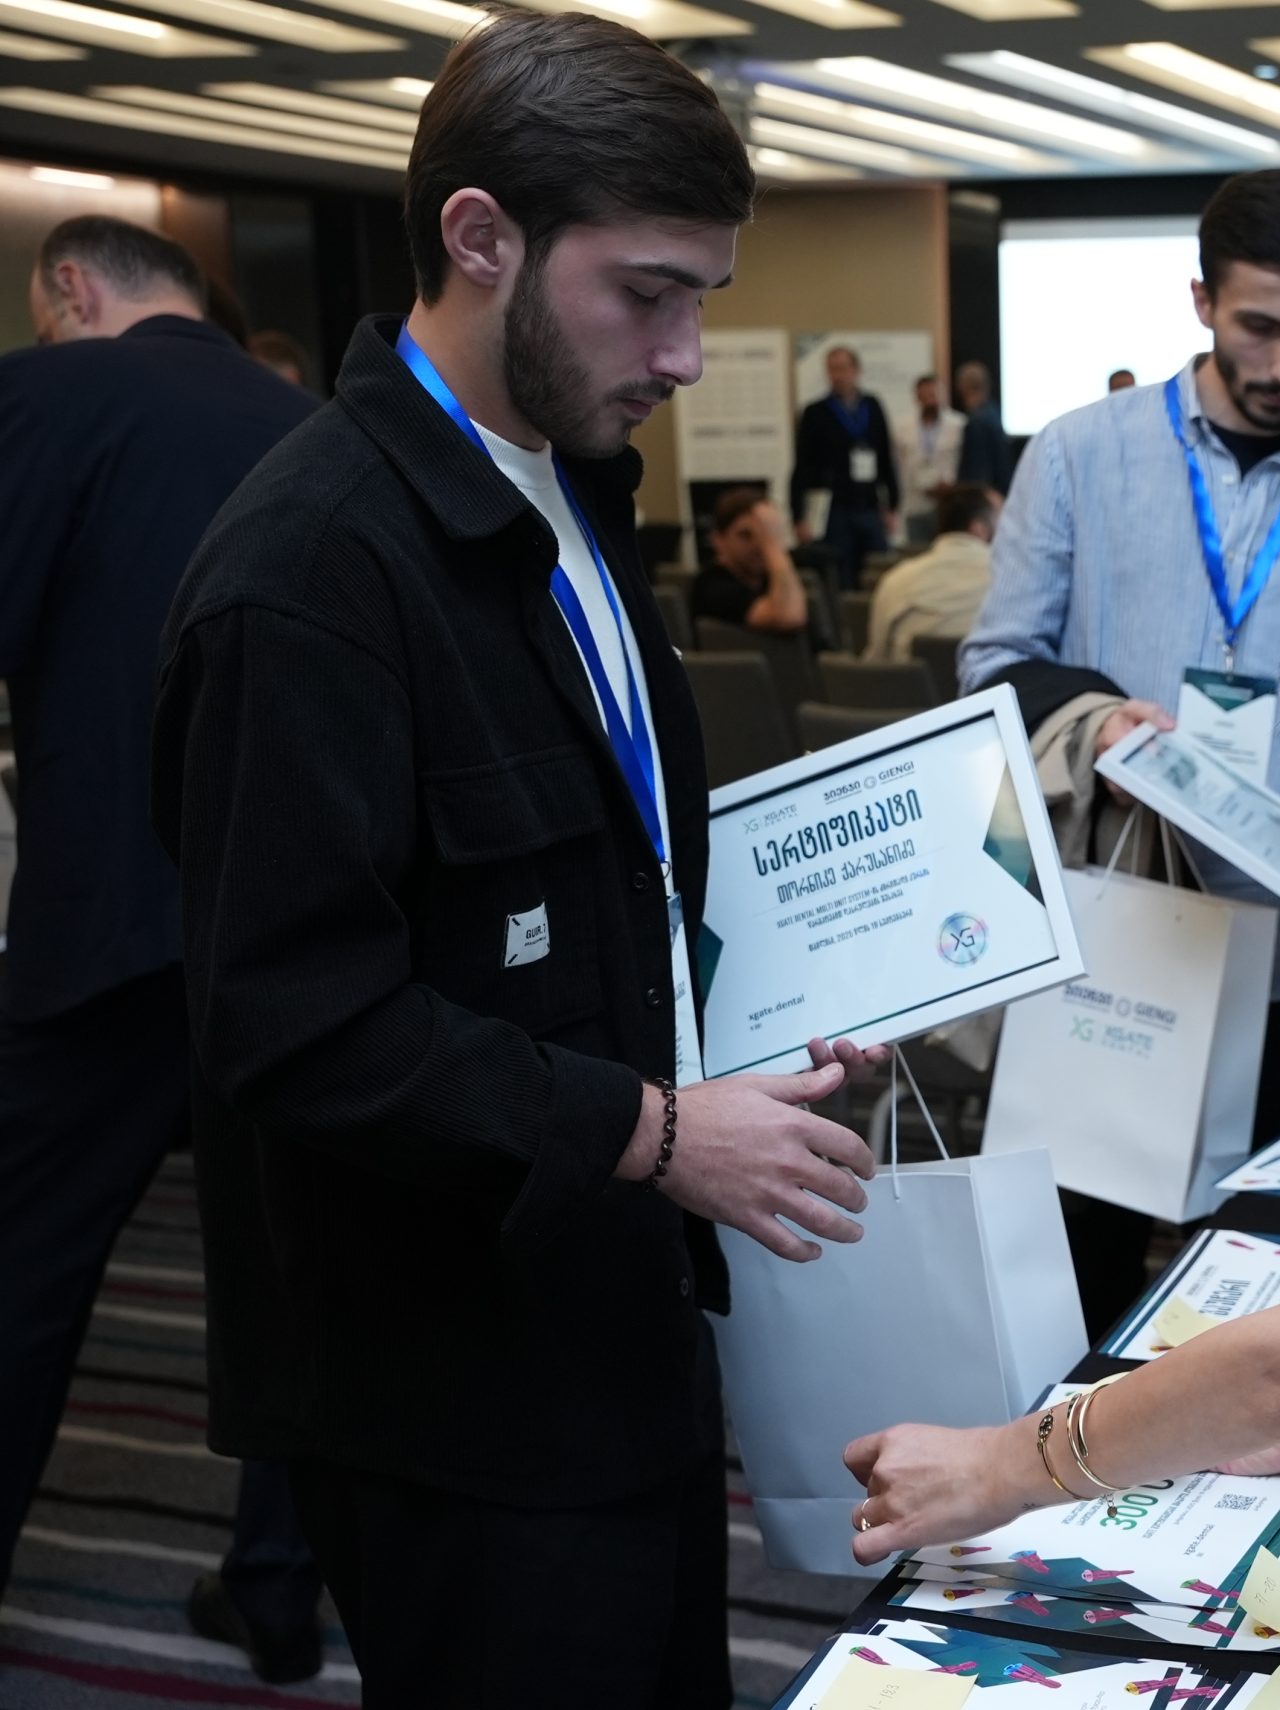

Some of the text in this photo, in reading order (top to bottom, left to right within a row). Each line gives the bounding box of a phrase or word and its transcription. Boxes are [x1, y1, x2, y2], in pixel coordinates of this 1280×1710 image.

[878, 761, 915, 781] GIENGI
[752, 788, 923, 877] სერტიფიკატი
[776, 866, 837, 904] თორნიკე
[748, 994, 805, 1022] xgate.dental
[1100, 1493, 1159, 1531] 300
